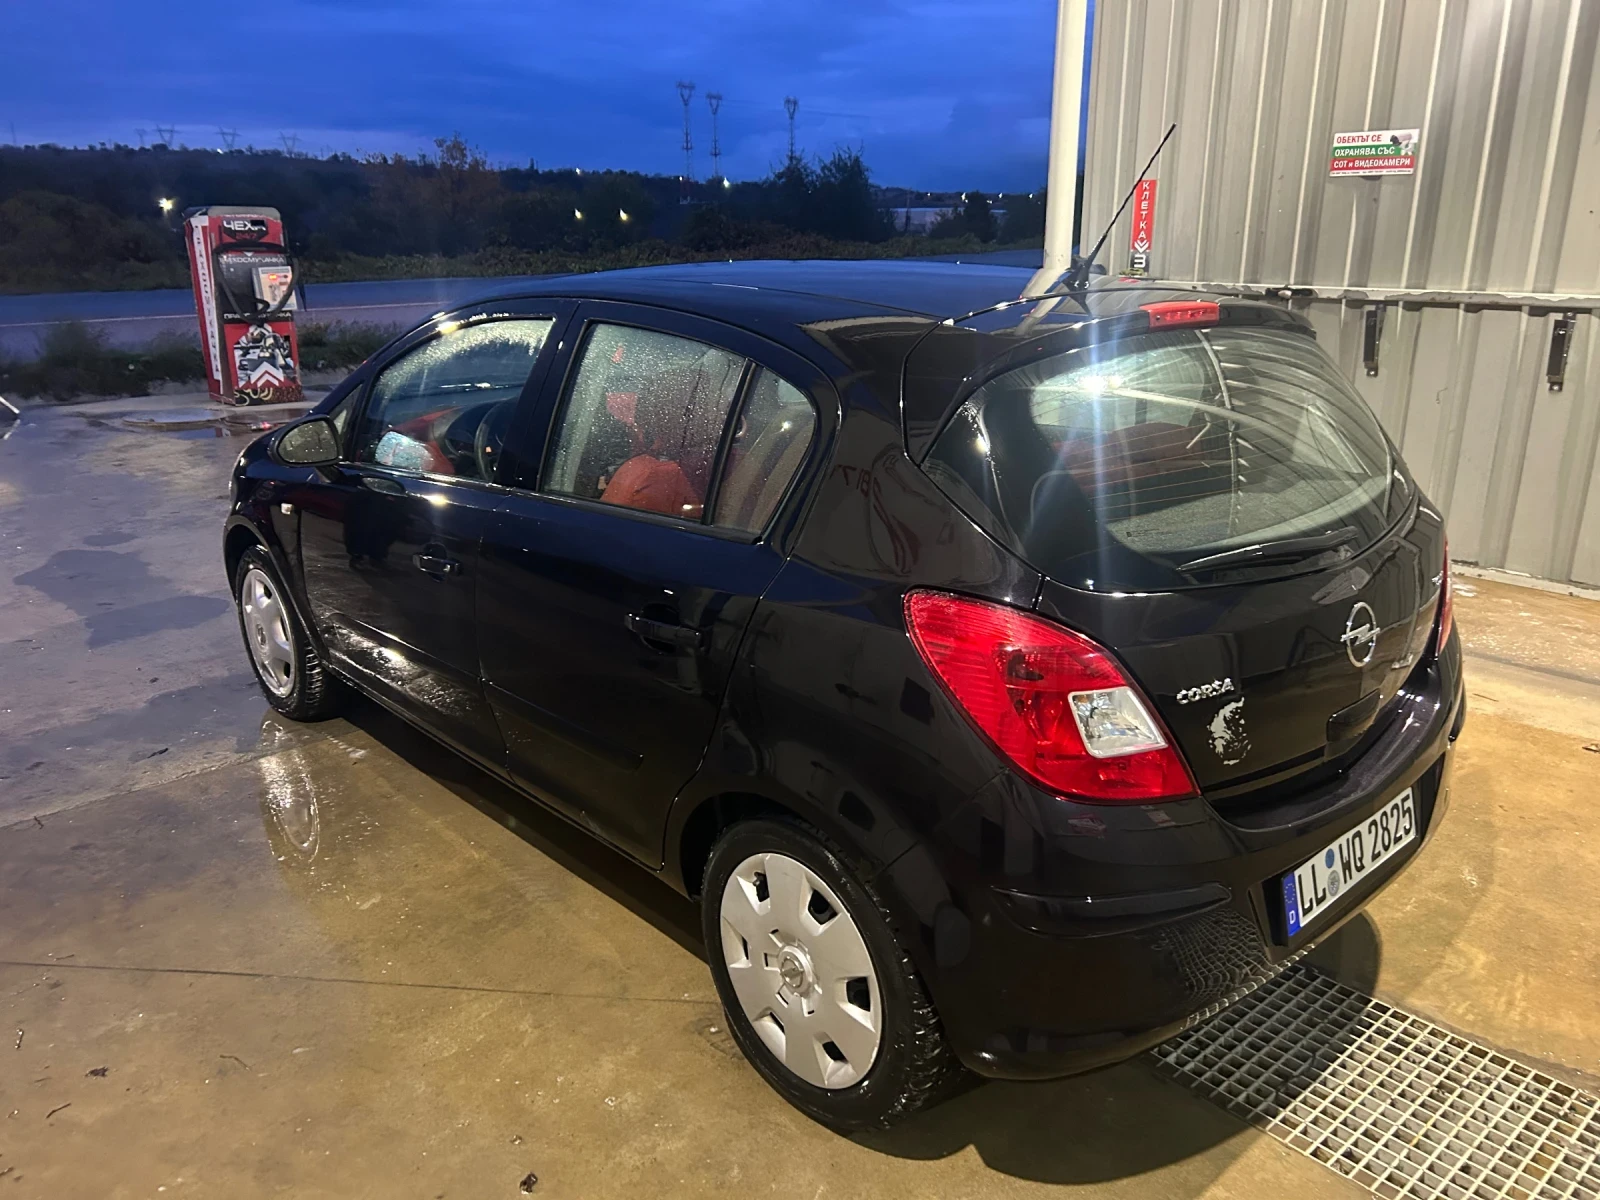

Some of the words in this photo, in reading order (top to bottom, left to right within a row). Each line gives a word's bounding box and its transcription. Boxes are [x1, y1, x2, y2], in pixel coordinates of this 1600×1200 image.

[1336, 135, 1370, 144] ОБЕКТЪТ
[1371, 134, 1382, 142] СЕ
[1334, 148, 1376, 157] ОХРАНЯВА
[1377, 146, 1395, 155] СЪС
[1333, 160, 1348, 168] СОТ
[1354, 158, 1411, 168] ВИДЕОКАМЕРИ
[1138, 181, 1150, 239] КЛЕТКА
[1133, 254, 1146, 268] 3
[1176, 678, 1235, 704] CORSA
[1297, 863, 1327, 917] LL
[1338, 829, 1366, 885] WQ
[1368, 793, 1413, 863] 2825
[1289, 910, 1297, 925] D
